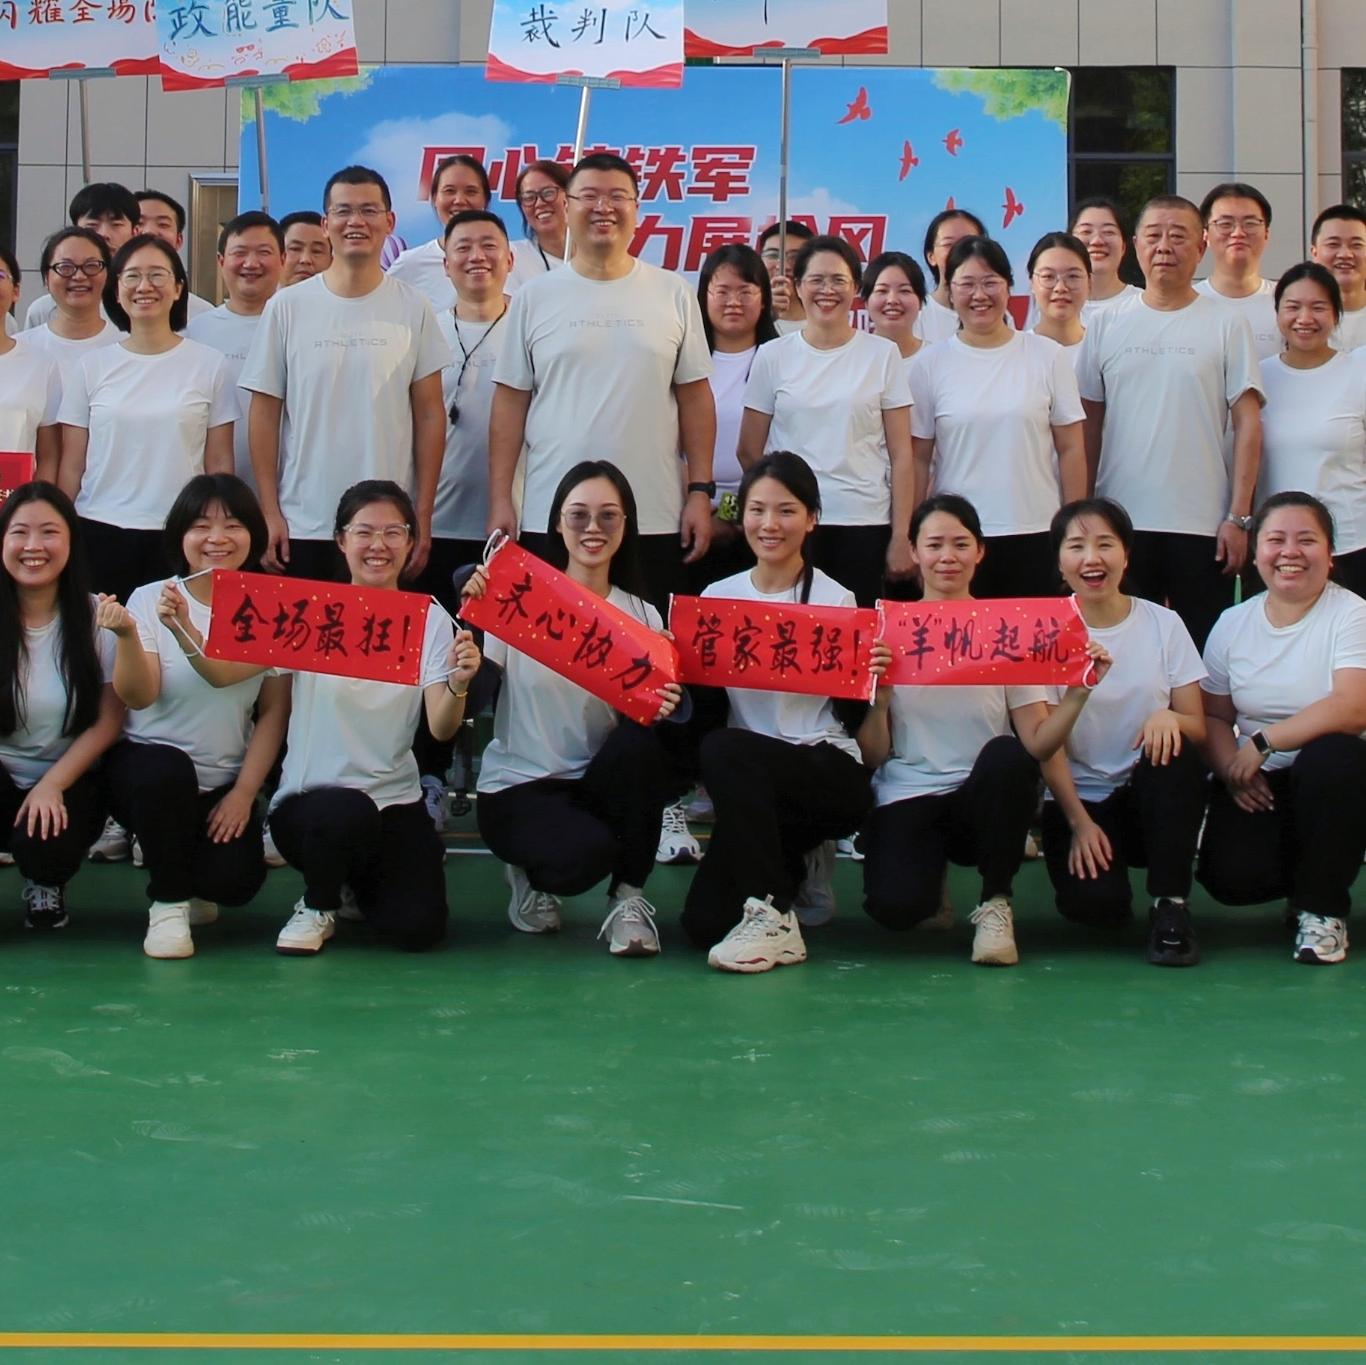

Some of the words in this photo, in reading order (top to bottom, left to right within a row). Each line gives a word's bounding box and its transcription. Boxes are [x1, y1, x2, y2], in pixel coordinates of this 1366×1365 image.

[520, 3, 667, 49] 裁判队
[314, 338, 387, 348] ATHLETICS
[569, 319, 645, 328] ATHLETICS
[1125, 346, 1196, 355] ATHLETICS
[231, 592, 411, 663] 全场最狂！
[494, 571, 653, 691] 齐心协力
[691, 612, 862, 677] 管家最强！
[897, 613, 1070, 671] “羊”帆起航
